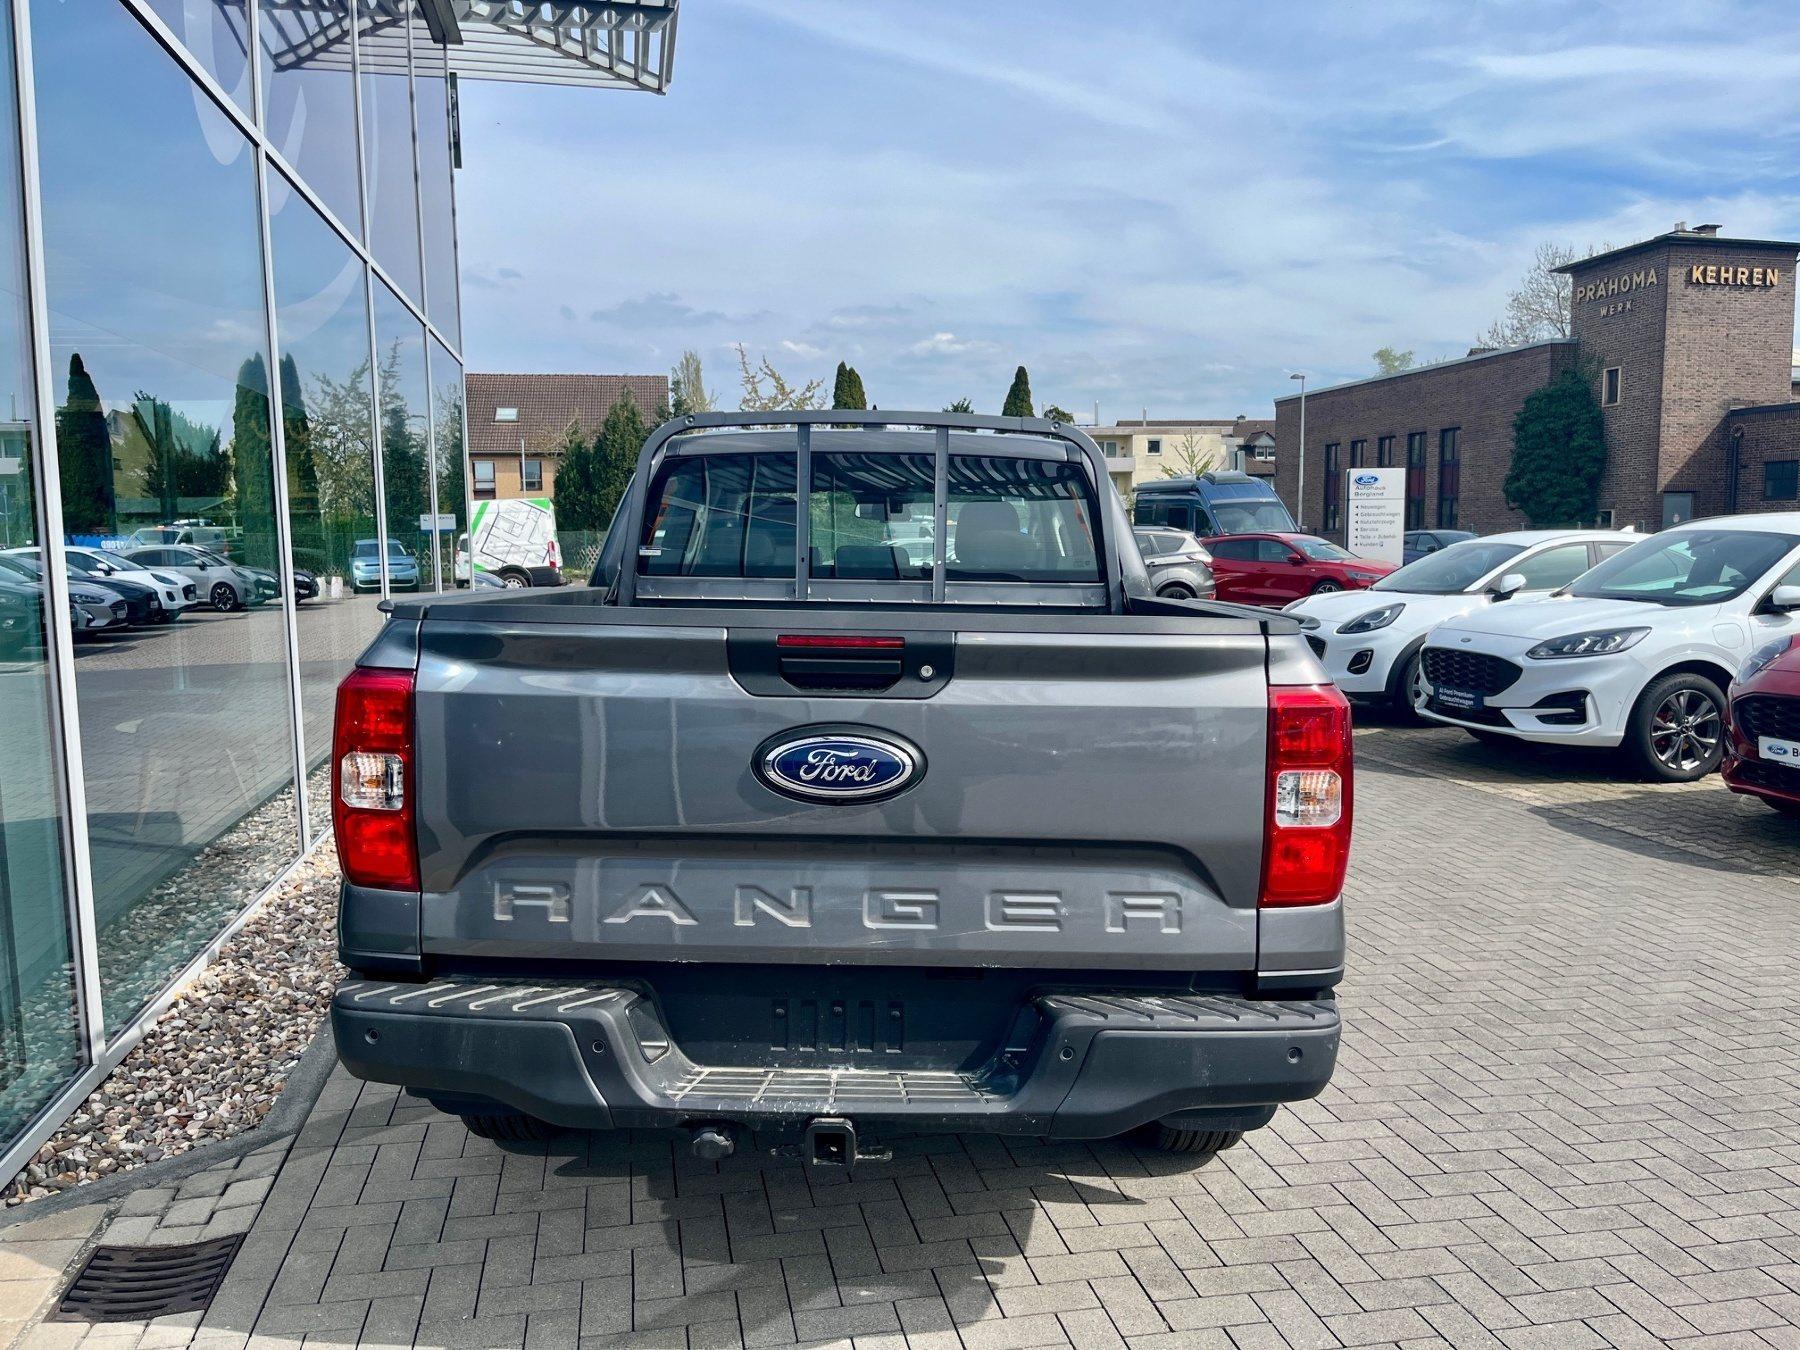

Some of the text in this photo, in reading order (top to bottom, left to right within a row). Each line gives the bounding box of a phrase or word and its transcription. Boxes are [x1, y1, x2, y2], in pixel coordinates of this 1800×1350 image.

[1576, 268, 1658, 303] PRÄHOMA
[1692, 265, 1779, 286] KEHREN
[1600, 301, 1633, 317] WERK
[799, 749, 880, 782] Ford
[494, 881, 1183, 934] RANGER
